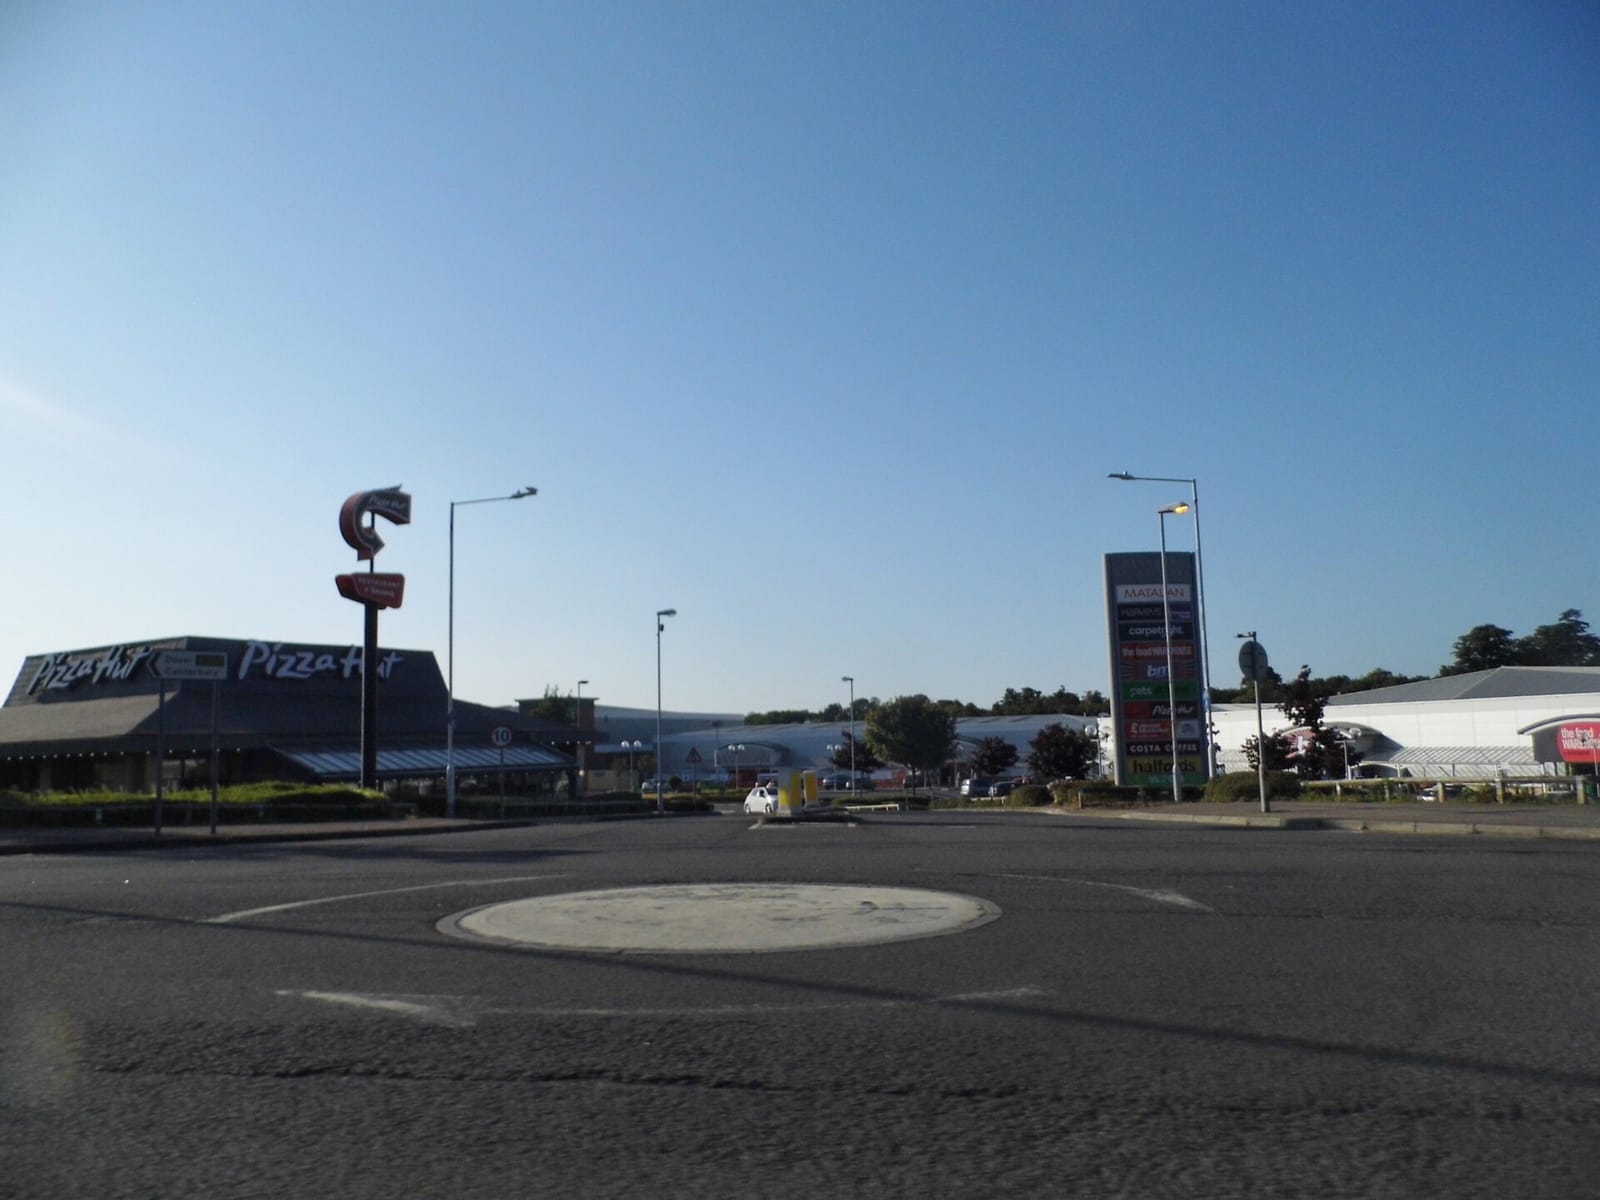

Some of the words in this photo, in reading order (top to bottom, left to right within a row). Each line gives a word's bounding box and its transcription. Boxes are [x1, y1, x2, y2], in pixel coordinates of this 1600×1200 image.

[1124, 587, 1184, 599] MATALAN
[237, 640, 338, 681] Pizza
[26, 651, 94, 695] Pizza
[91, 645, 153, 685] Hut
[495, 730, 509, 742] 10
[1561, 727, 1575, 738] the
[1575, 727, 1594, 738] fod
[1130, 744, 1161, 753] COSTA
[1133, 759, 1196, 773] halfods
